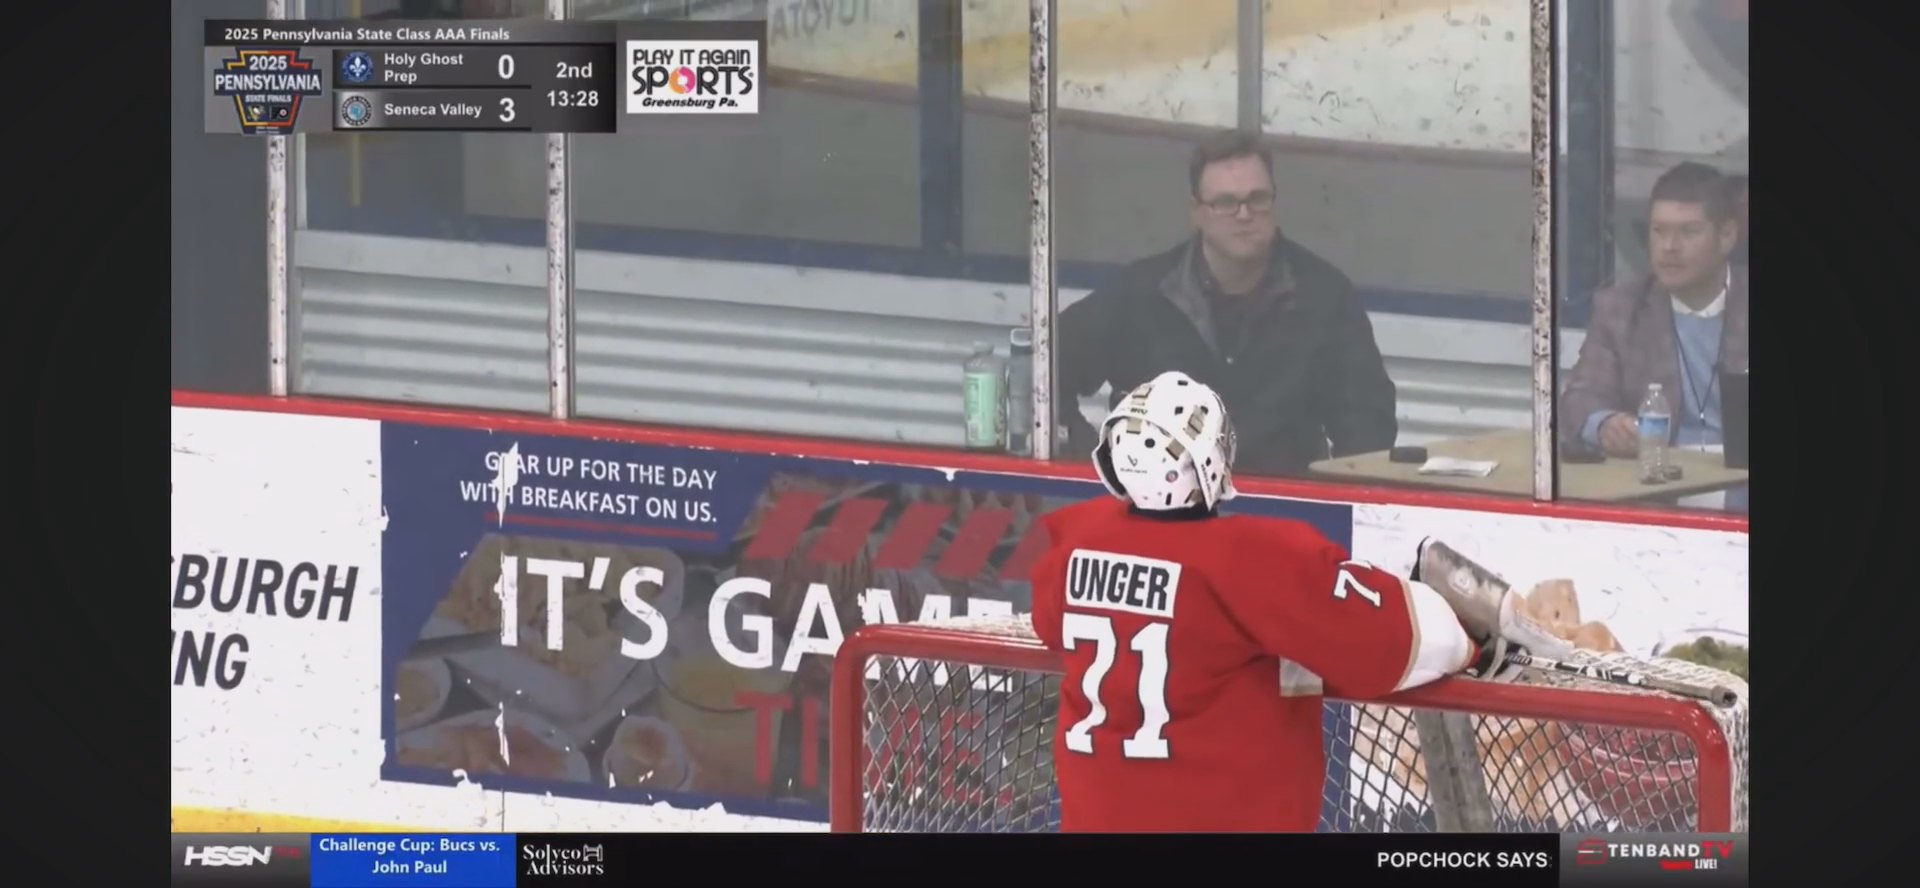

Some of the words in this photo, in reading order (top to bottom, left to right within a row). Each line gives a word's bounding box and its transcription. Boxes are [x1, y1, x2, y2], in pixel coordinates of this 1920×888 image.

[484, 451, 540, 475] GAR
[547, 457, 574, 477] UP
[580, 459, 621, 482] FOR
[626, 463, 665, 486] THE
[671, 467, 718, 491] DAY
[521, 486, 639, 516] BREAKFAST
[645, 497, 677, 520] ON
[684, 500, 718, 523] US.
[171, 553, 360, 623] BURGH
[499, 556, 669, 660] IT'S
[1069, 557, 1170, 612] UNGER
[1061, 612, 1171, 760] 71
